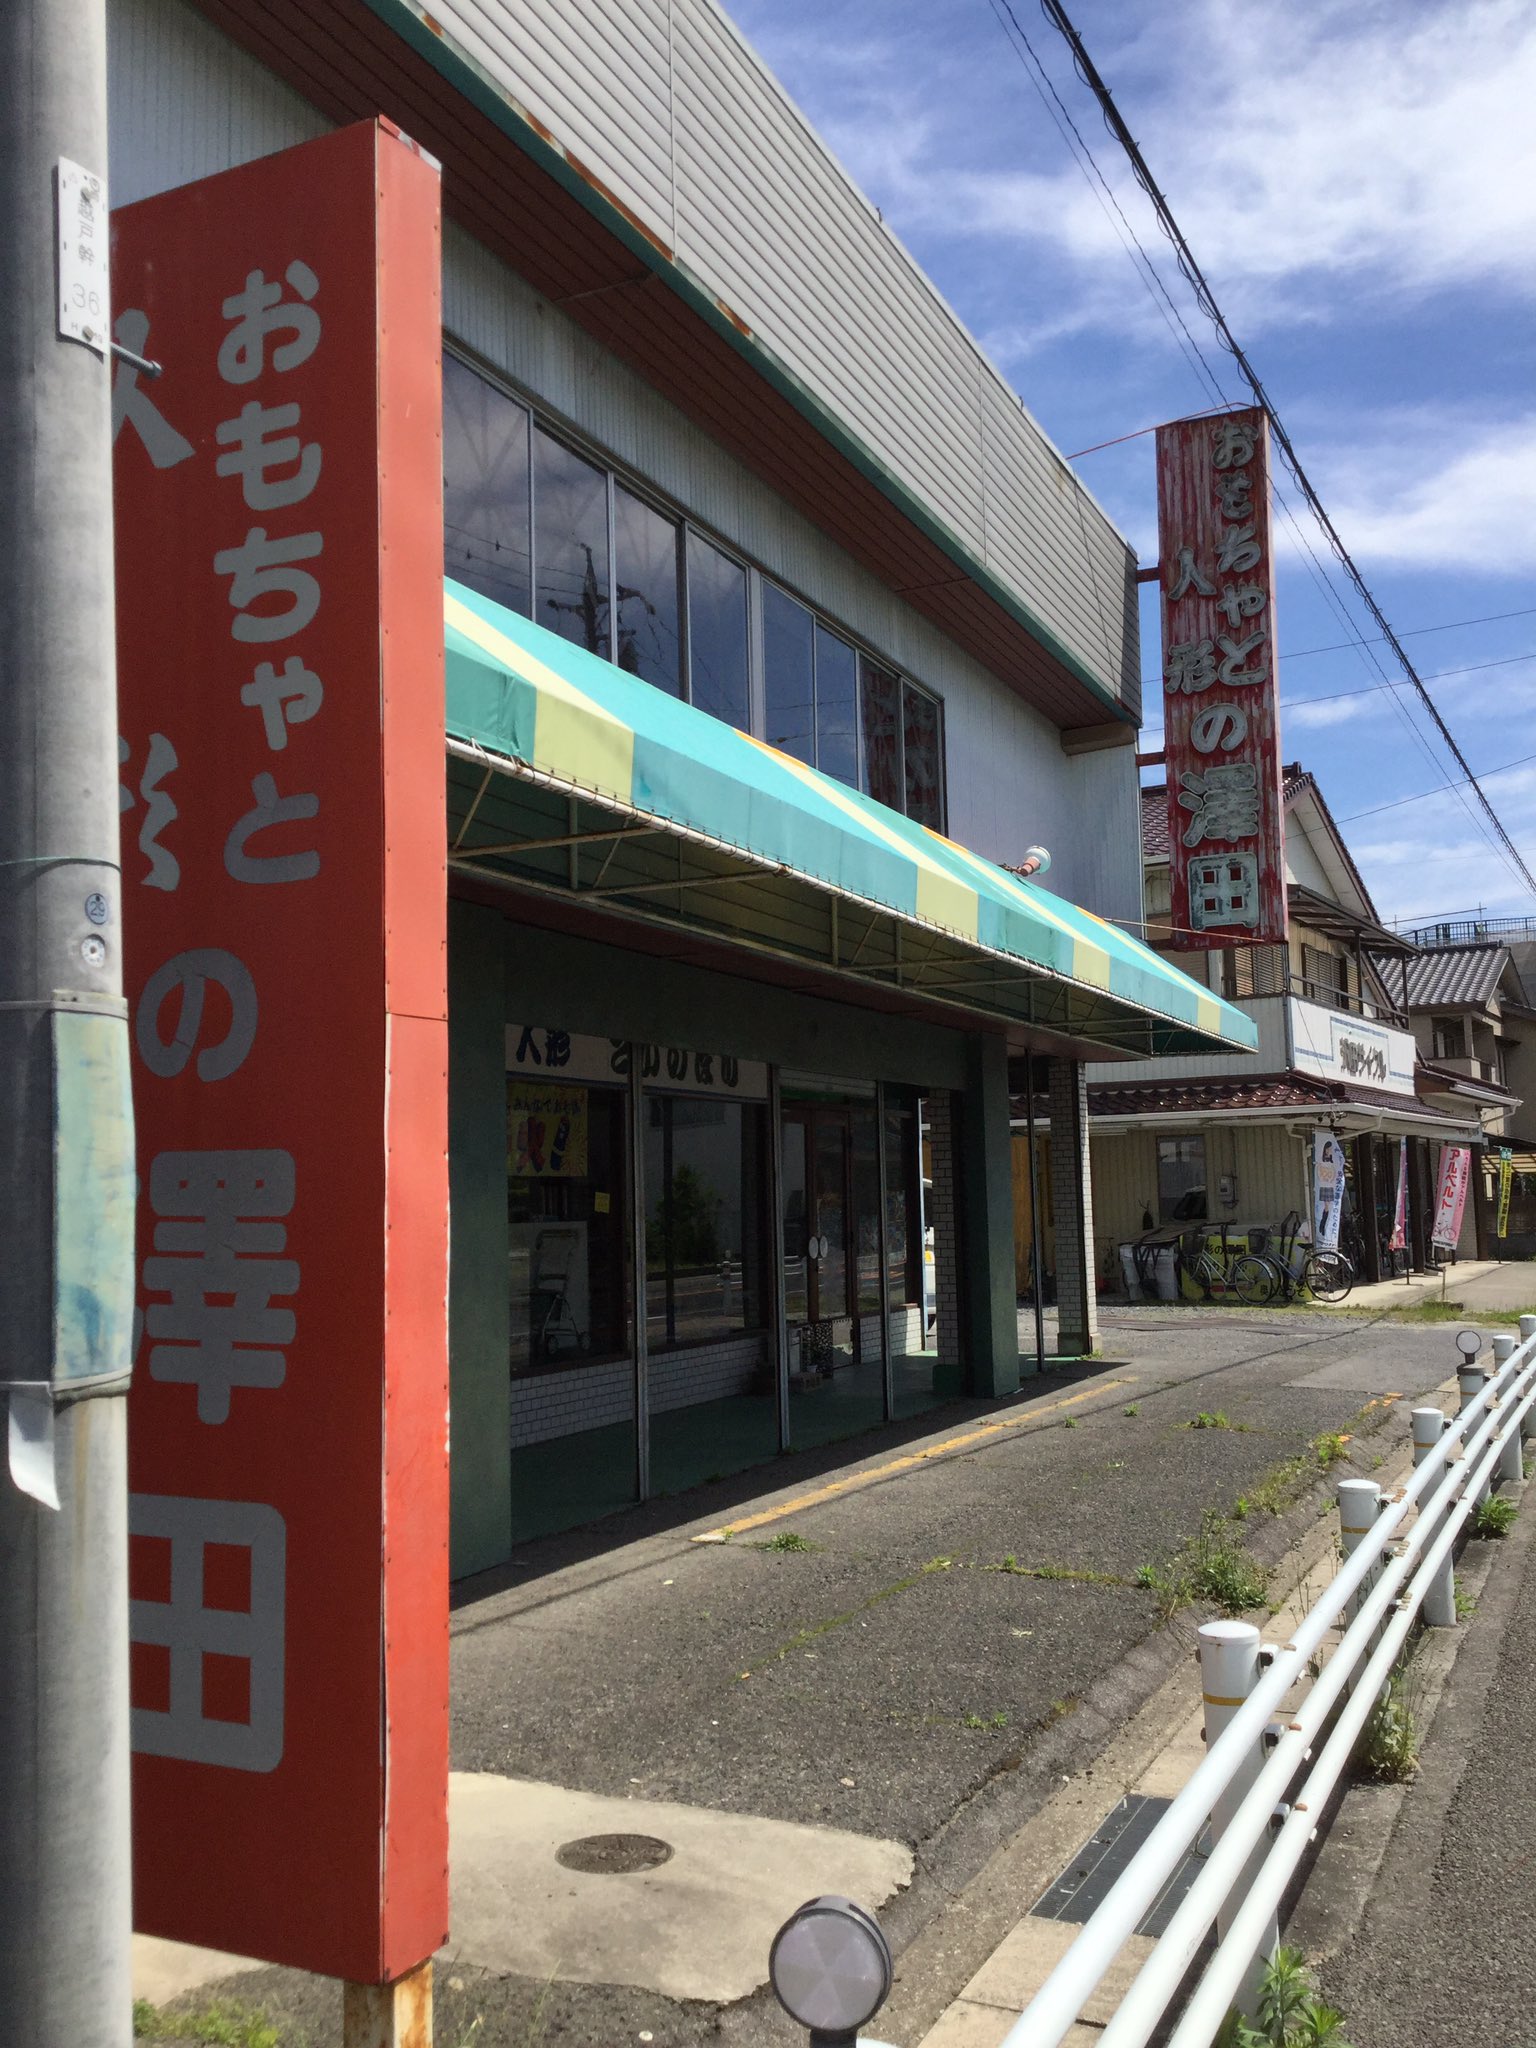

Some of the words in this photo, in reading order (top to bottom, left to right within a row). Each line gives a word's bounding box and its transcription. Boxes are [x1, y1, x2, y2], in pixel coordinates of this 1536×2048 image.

[72, 283, 101, 317] 36
[213, 259, 324, 885] おもちゃと
[1164, 546, 1218, 695] 人形
[1210, 419, 1267, 687] おもちゃと
[1177, 702, 1260, 932] の澤田
[1441, 1149, 1461, 1211] アルベルト
